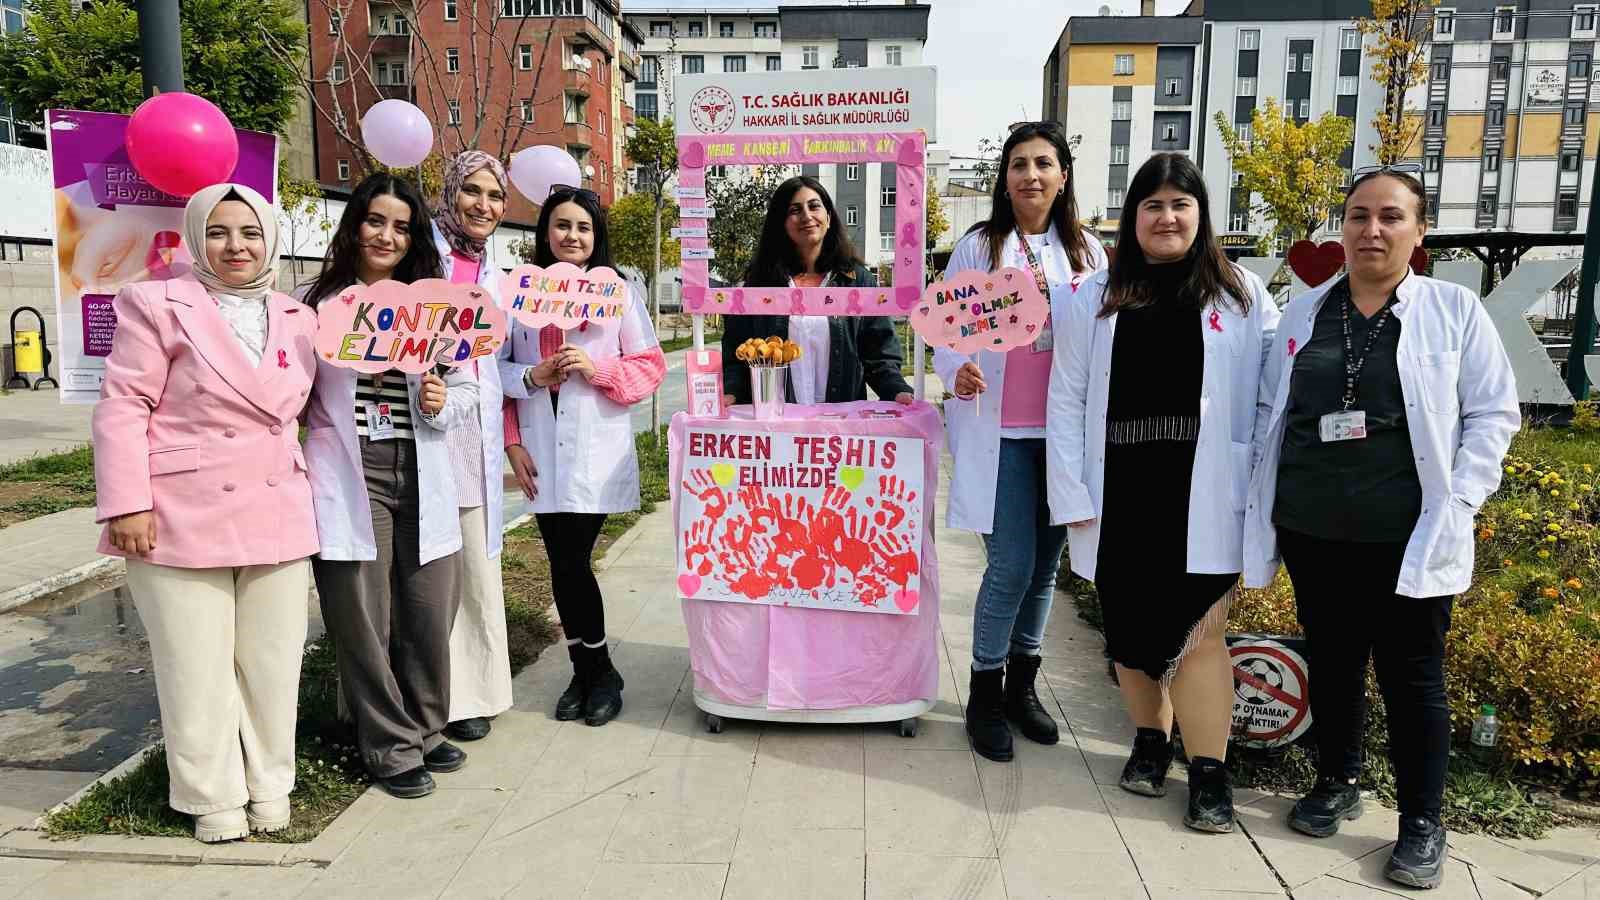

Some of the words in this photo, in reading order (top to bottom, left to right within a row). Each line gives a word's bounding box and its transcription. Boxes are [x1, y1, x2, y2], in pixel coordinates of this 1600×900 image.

[742, 95, 768, 109] T.C.
[771, 89, 823, 108] SAĞLIK
[827, 87, 910, 106] BAKANLIĞI
[743, 112, 789, 127] HAKKARİ
[791, 111, 800, 126] İL
[802, 110, 840, 126] SAĞLIK
[843, 108, 910, 125] MÜDÜRLÜĞÜ
[512, 294, 564, 314] HAYAT
[936, 284, 979, 305] BANA
[971, 290, 1023, 316] OLMAZ
[352, 302, 492, 335] KONTROL
[960, 316, 999, 337] DEME
[338, 332, 494, 364] ELİMİZDE
[689, 432, 772, 460] ERKEN
[738, 462, 838, 489] ELİMİZDE
[1243, 704, 1290, 718] OYNAMAK
